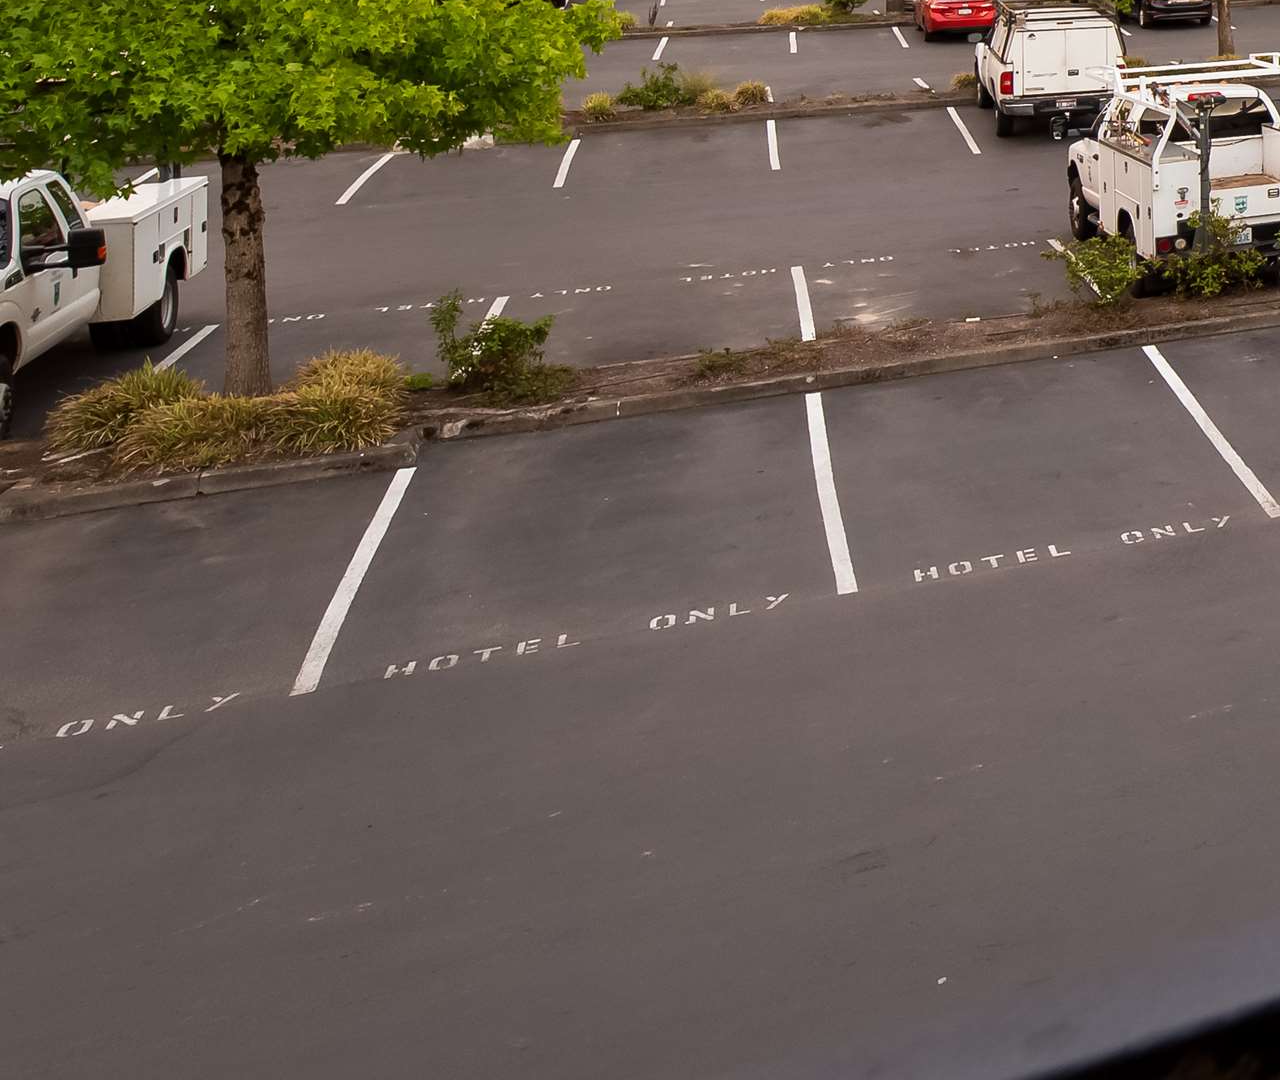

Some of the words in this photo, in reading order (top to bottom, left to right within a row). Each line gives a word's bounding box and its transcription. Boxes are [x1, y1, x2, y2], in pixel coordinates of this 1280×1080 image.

[913, 544, 1072, 583] HOTEL
[1120, 515, 1231, 545] ONLY
[383, 633, 581, 680] HOTEL
[649, 592, 790, 631] ONLY
[55, 691, 241, 738] ONLY
